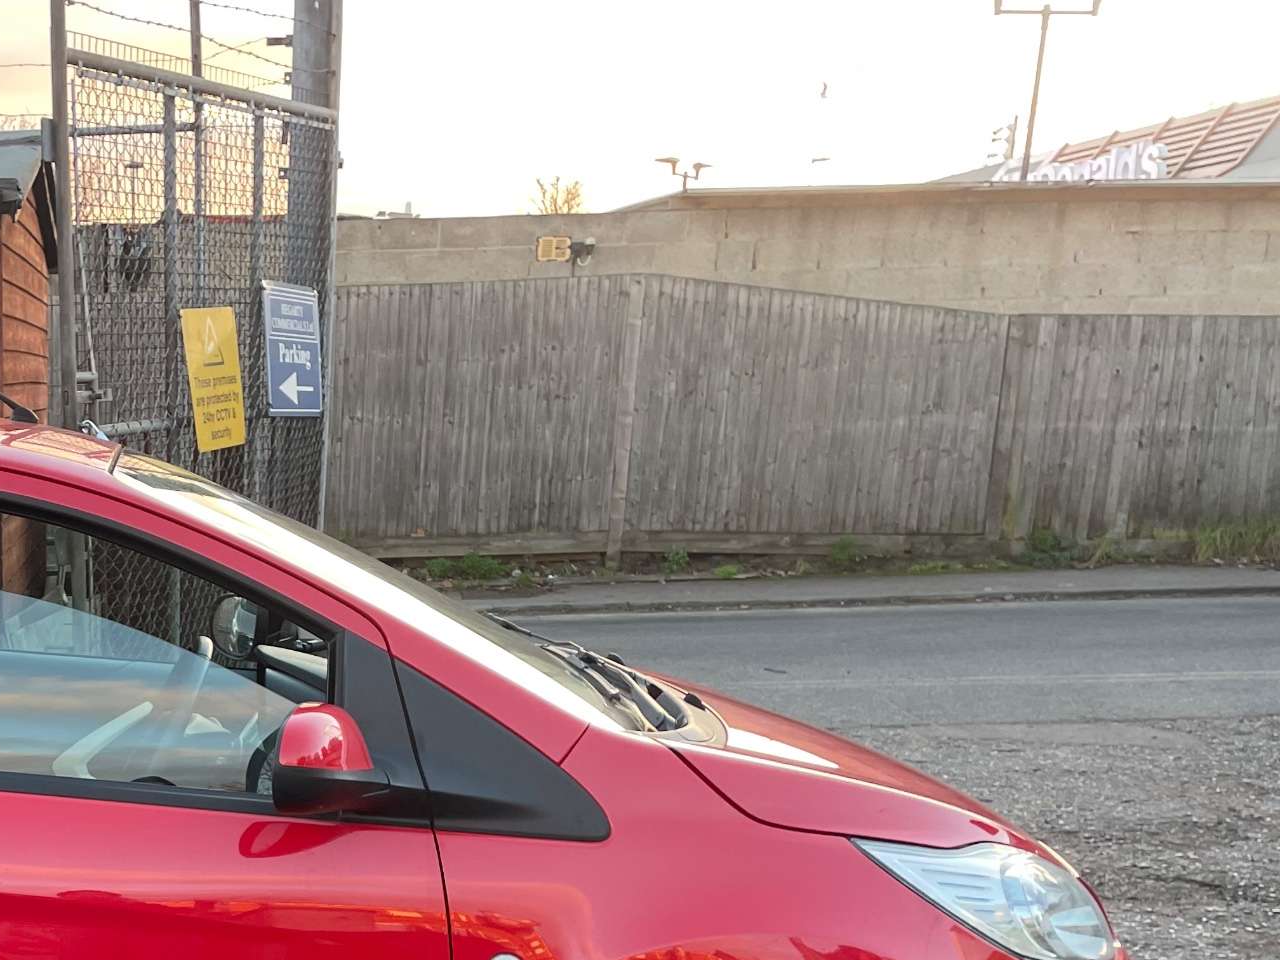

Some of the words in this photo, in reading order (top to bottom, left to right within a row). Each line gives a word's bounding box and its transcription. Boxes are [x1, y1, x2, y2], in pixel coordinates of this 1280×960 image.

[278, 342, 312, 370] Parking
[212, 375, 237, 389] premises
[206, 392, 232, 409] protected
[215, 408, 231, 421] CCTV
[211, 427, 232, 441] security
